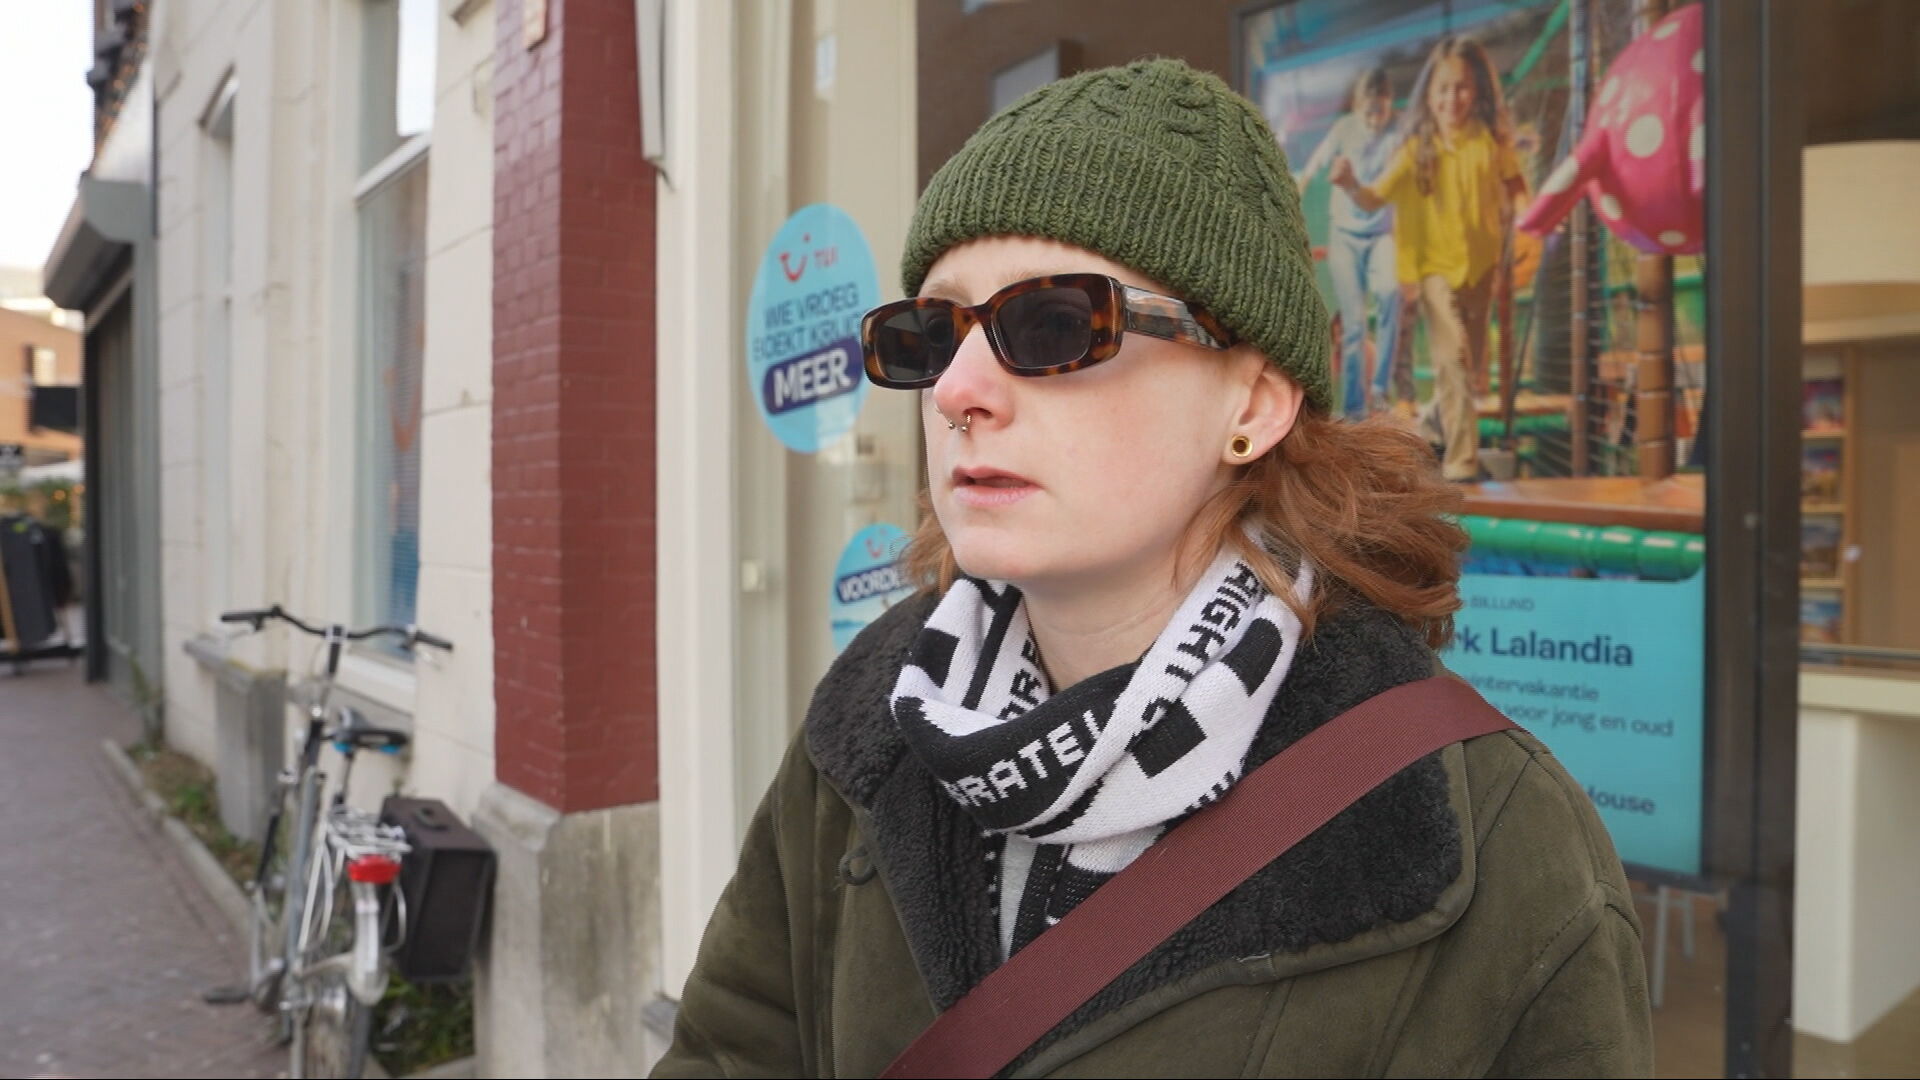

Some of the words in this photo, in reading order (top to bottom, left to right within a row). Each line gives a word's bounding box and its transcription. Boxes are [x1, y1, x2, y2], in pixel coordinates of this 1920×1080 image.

[796, 282, 859, 320] VROEG
[773, 347, 851, 407] MEER
[1470, 596, 1535, 612] BILLUND
[1491, 627, 1634, 667] Lalandia
[1503, 704, 1549, 721] voor
[1551, 706, 1597, 733] jong
[1601, 715, 1627, 730] en
[1631, 719, 1675, 738] oud
